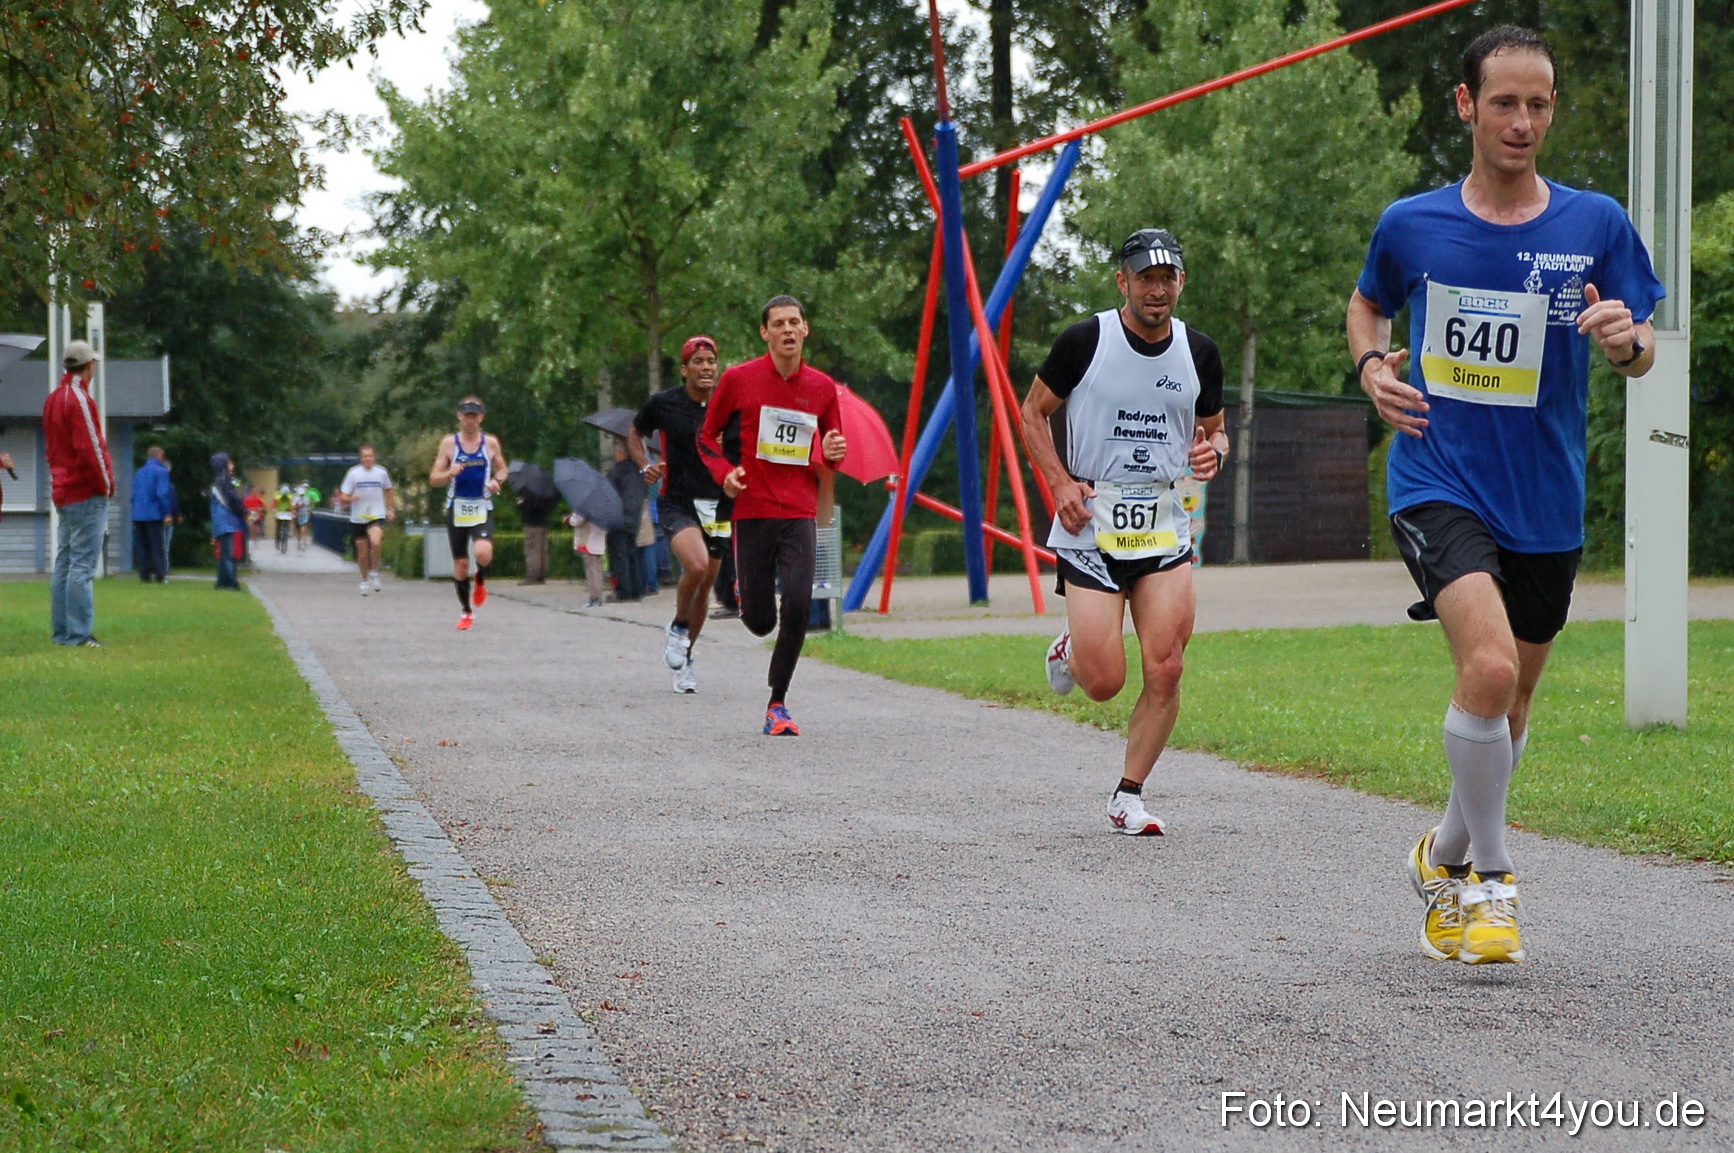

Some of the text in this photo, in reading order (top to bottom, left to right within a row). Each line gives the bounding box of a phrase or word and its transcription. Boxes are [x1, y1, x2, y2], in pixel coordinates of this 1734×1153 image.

[1517, 252, 1534, 261] 12.
[1459, 295, 1509, 310] BOCK
[1445, 317, 1519, 363] 640
[1453, 367, 1500, 388] Simon
[1118, 409, 1166, 425] Radsport
[775, 424, 797, 443] 49
[1113, 426, 1168, 440] Neumüller
[774, 447, 796, 456] Robert
[1113, 502, 1157, 530] 661
[1117, 536, 1157, 548] Michael
